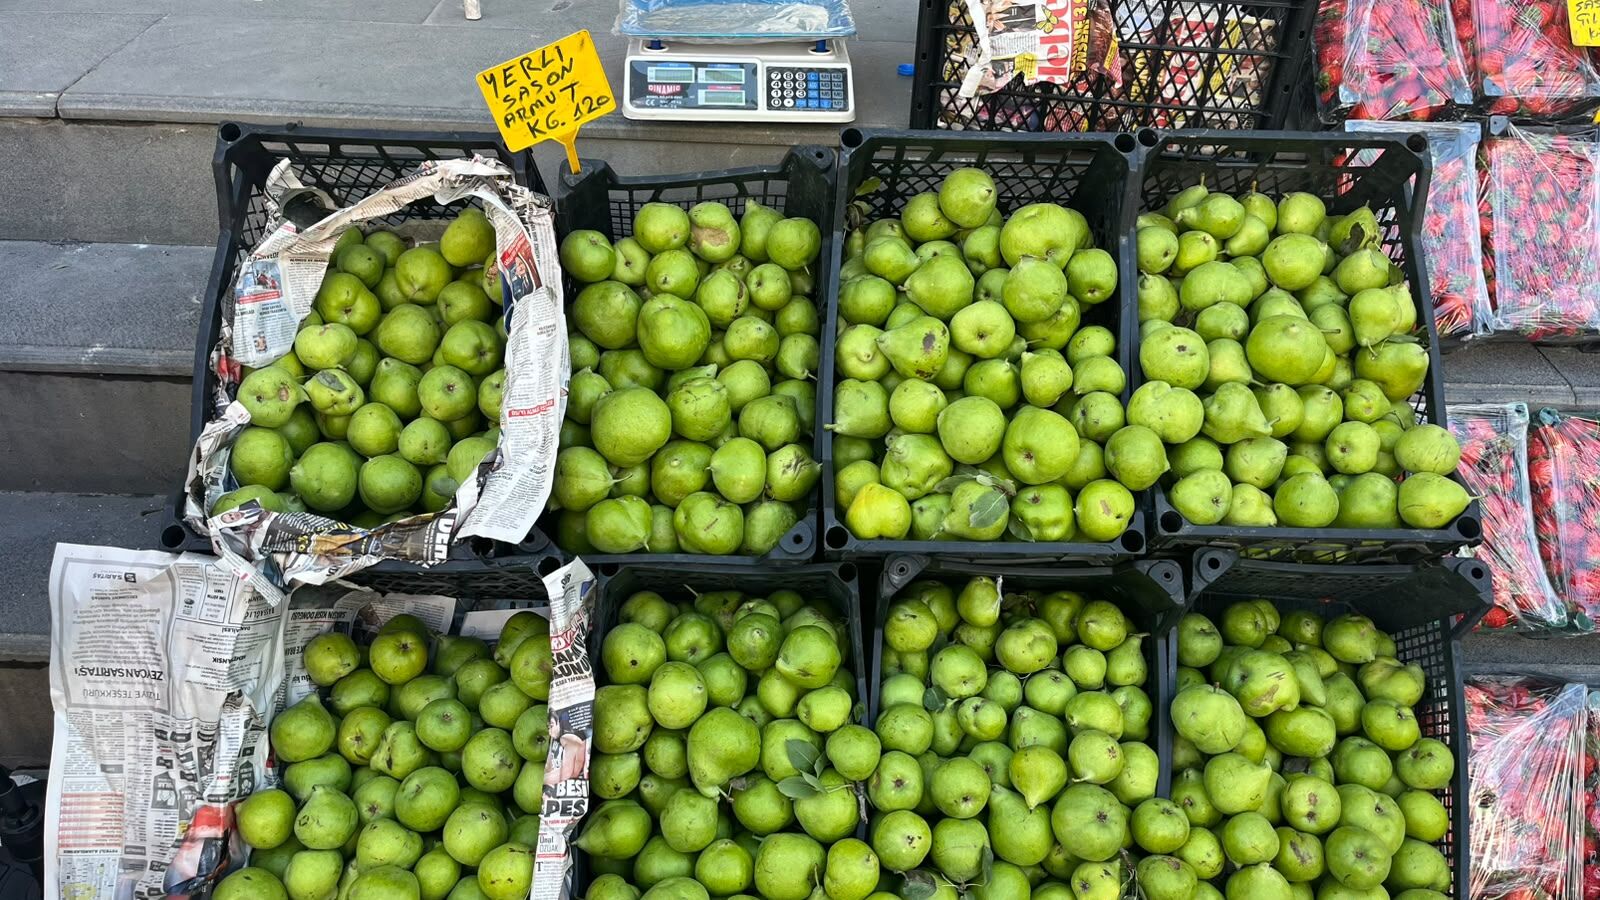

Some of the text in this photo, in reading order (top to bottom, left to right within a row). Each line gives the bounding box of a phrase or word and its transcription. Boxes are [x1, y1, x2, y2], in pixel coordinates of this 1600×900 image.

[502, 57, 574, 111] SASON
[503, 80, 580, 129] ARMUT
[573, 95, 611, 122] 120
[125, 668, 163, 681] ZEYCAN
[82, 688, 132, 700] TEŞEKKÜRÜ
